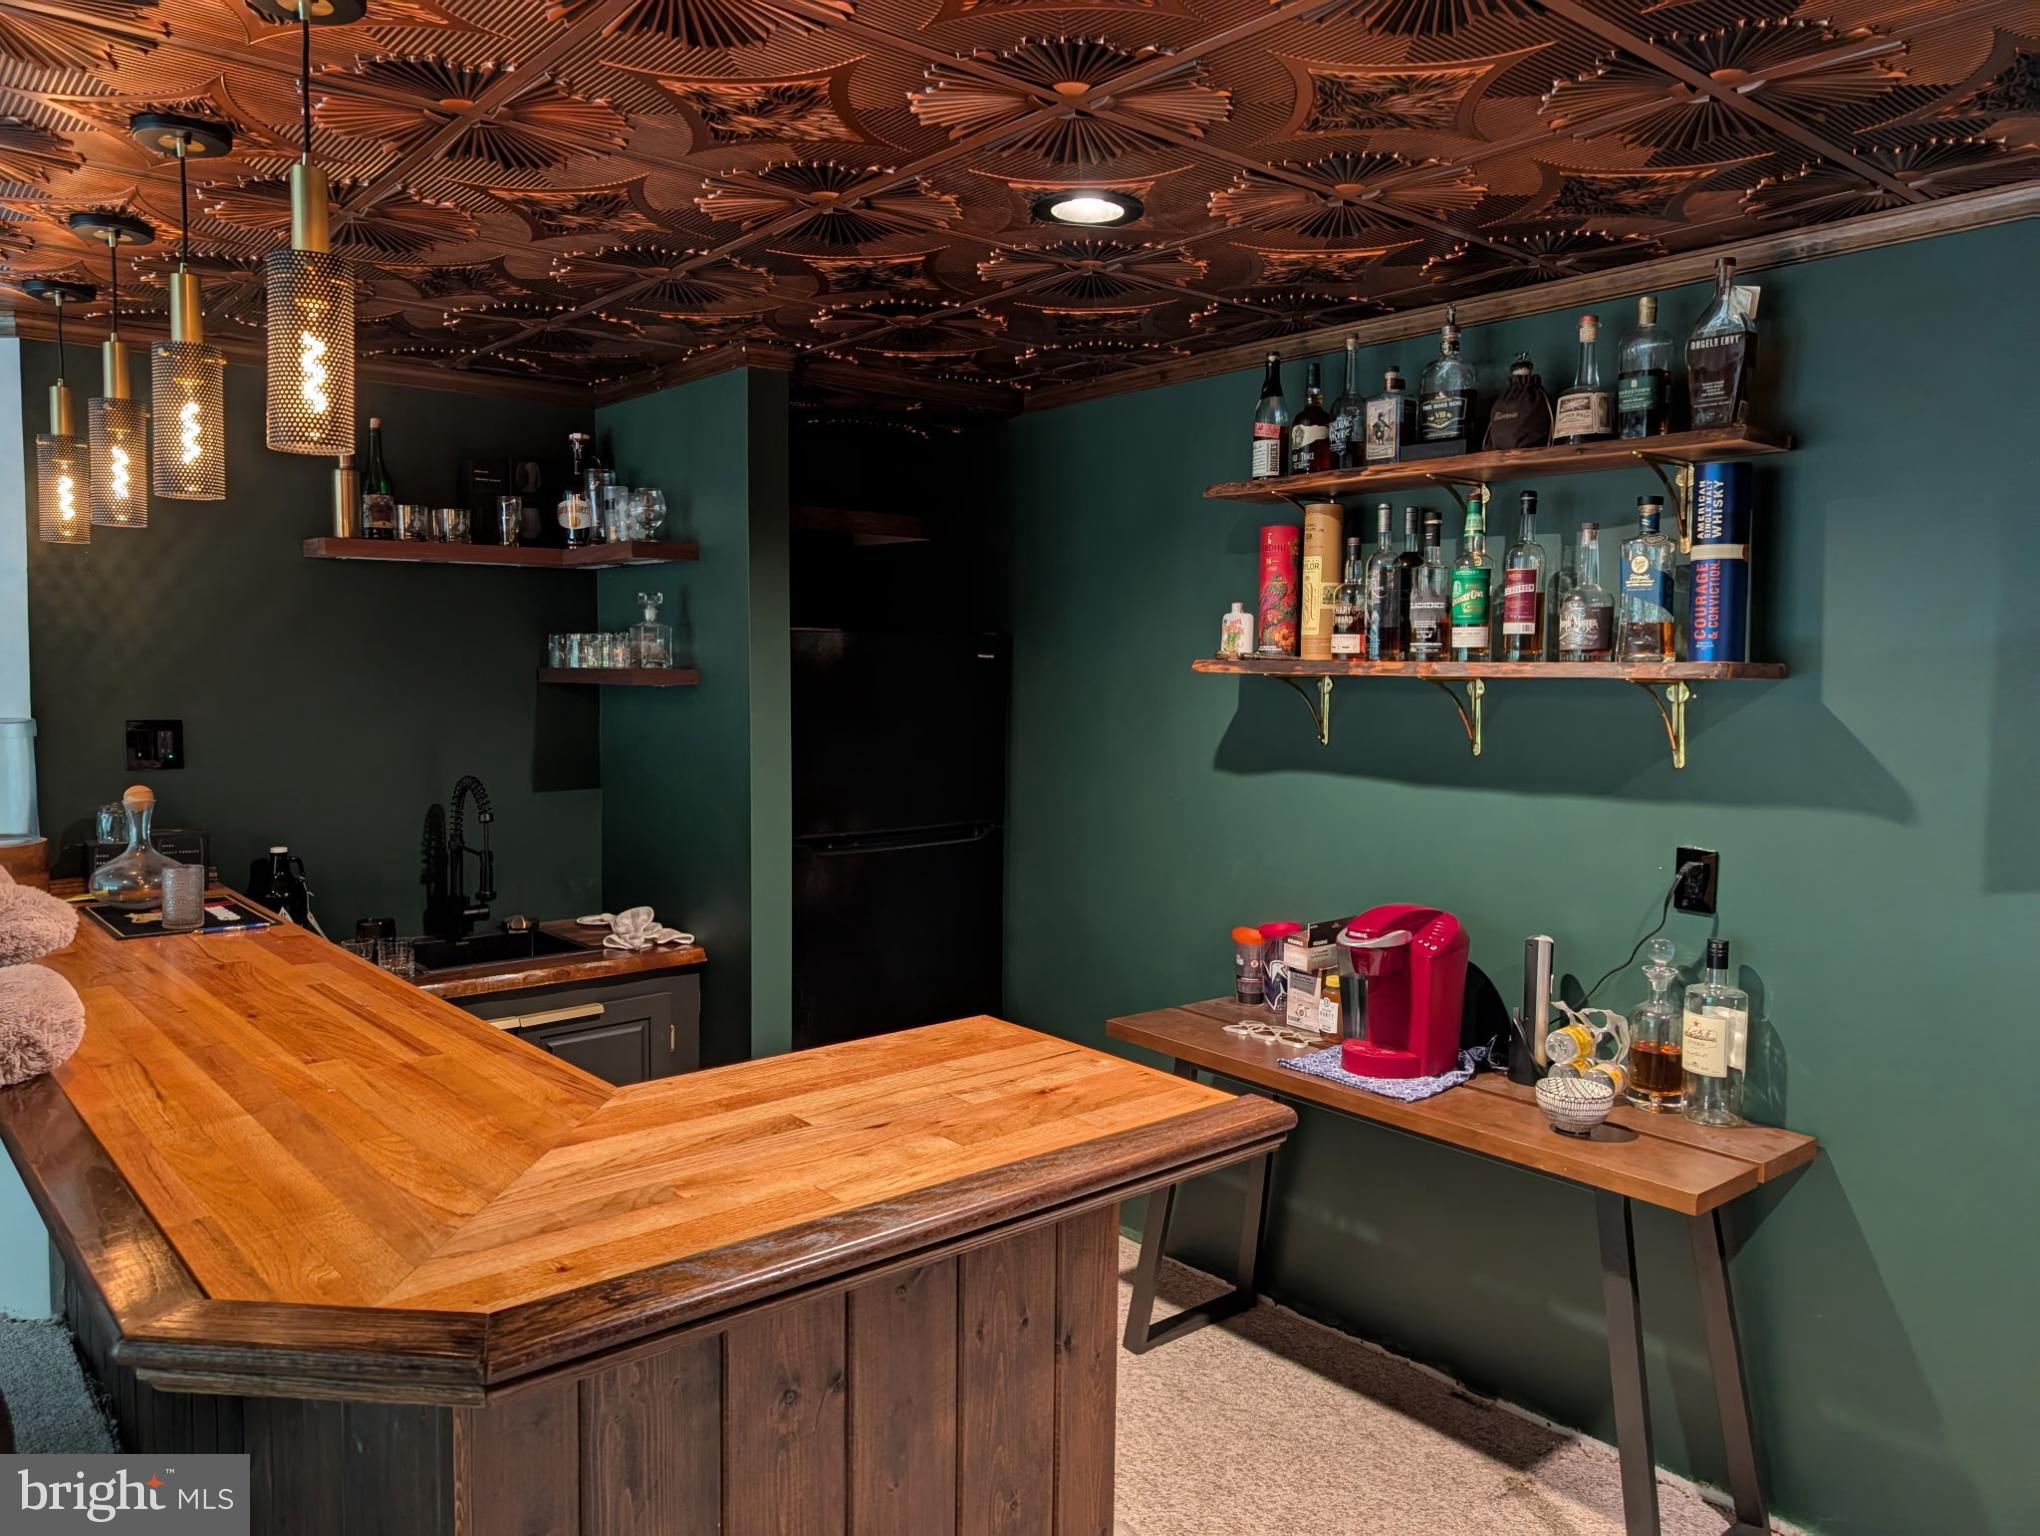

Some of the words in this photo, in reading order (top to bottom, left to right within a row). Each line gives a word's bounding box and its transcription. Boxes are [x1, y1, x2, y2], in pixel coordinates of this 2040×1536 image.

[1705, 480, 1713, 502] MALT
[1696, 480, 1706, 540] AMERICAN
[1704, 504, 1712, 539] SINGLE
[1711, 480, 1725, 539] WHISKY
[1694, 563, 1708, 641] COURAGE
[1709, 630, 1719, 640] &
[1349, 931, 1368, 939] KEURIG
